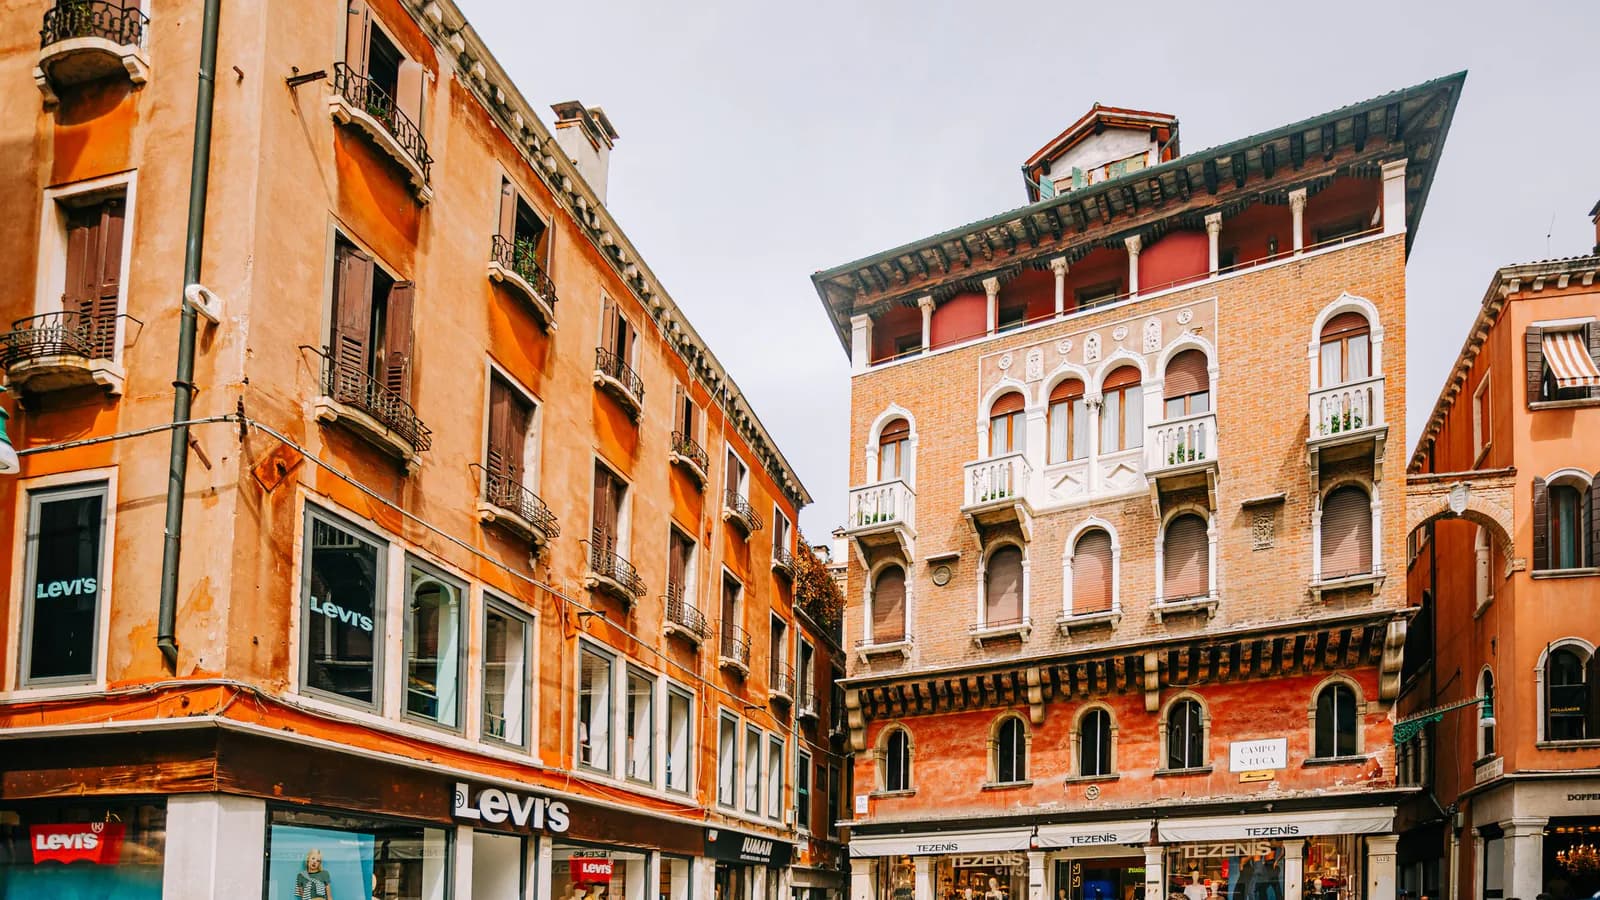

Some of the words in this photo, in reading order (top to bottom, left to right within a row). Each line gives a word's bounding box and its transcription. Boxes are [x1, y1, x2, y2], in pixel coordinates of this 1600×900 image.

[1240, 745, 1276, 754] CAMPO
[1249, 756, 1275, 765] LUCA
[1567, 793, 1600, 801] DOPPE
